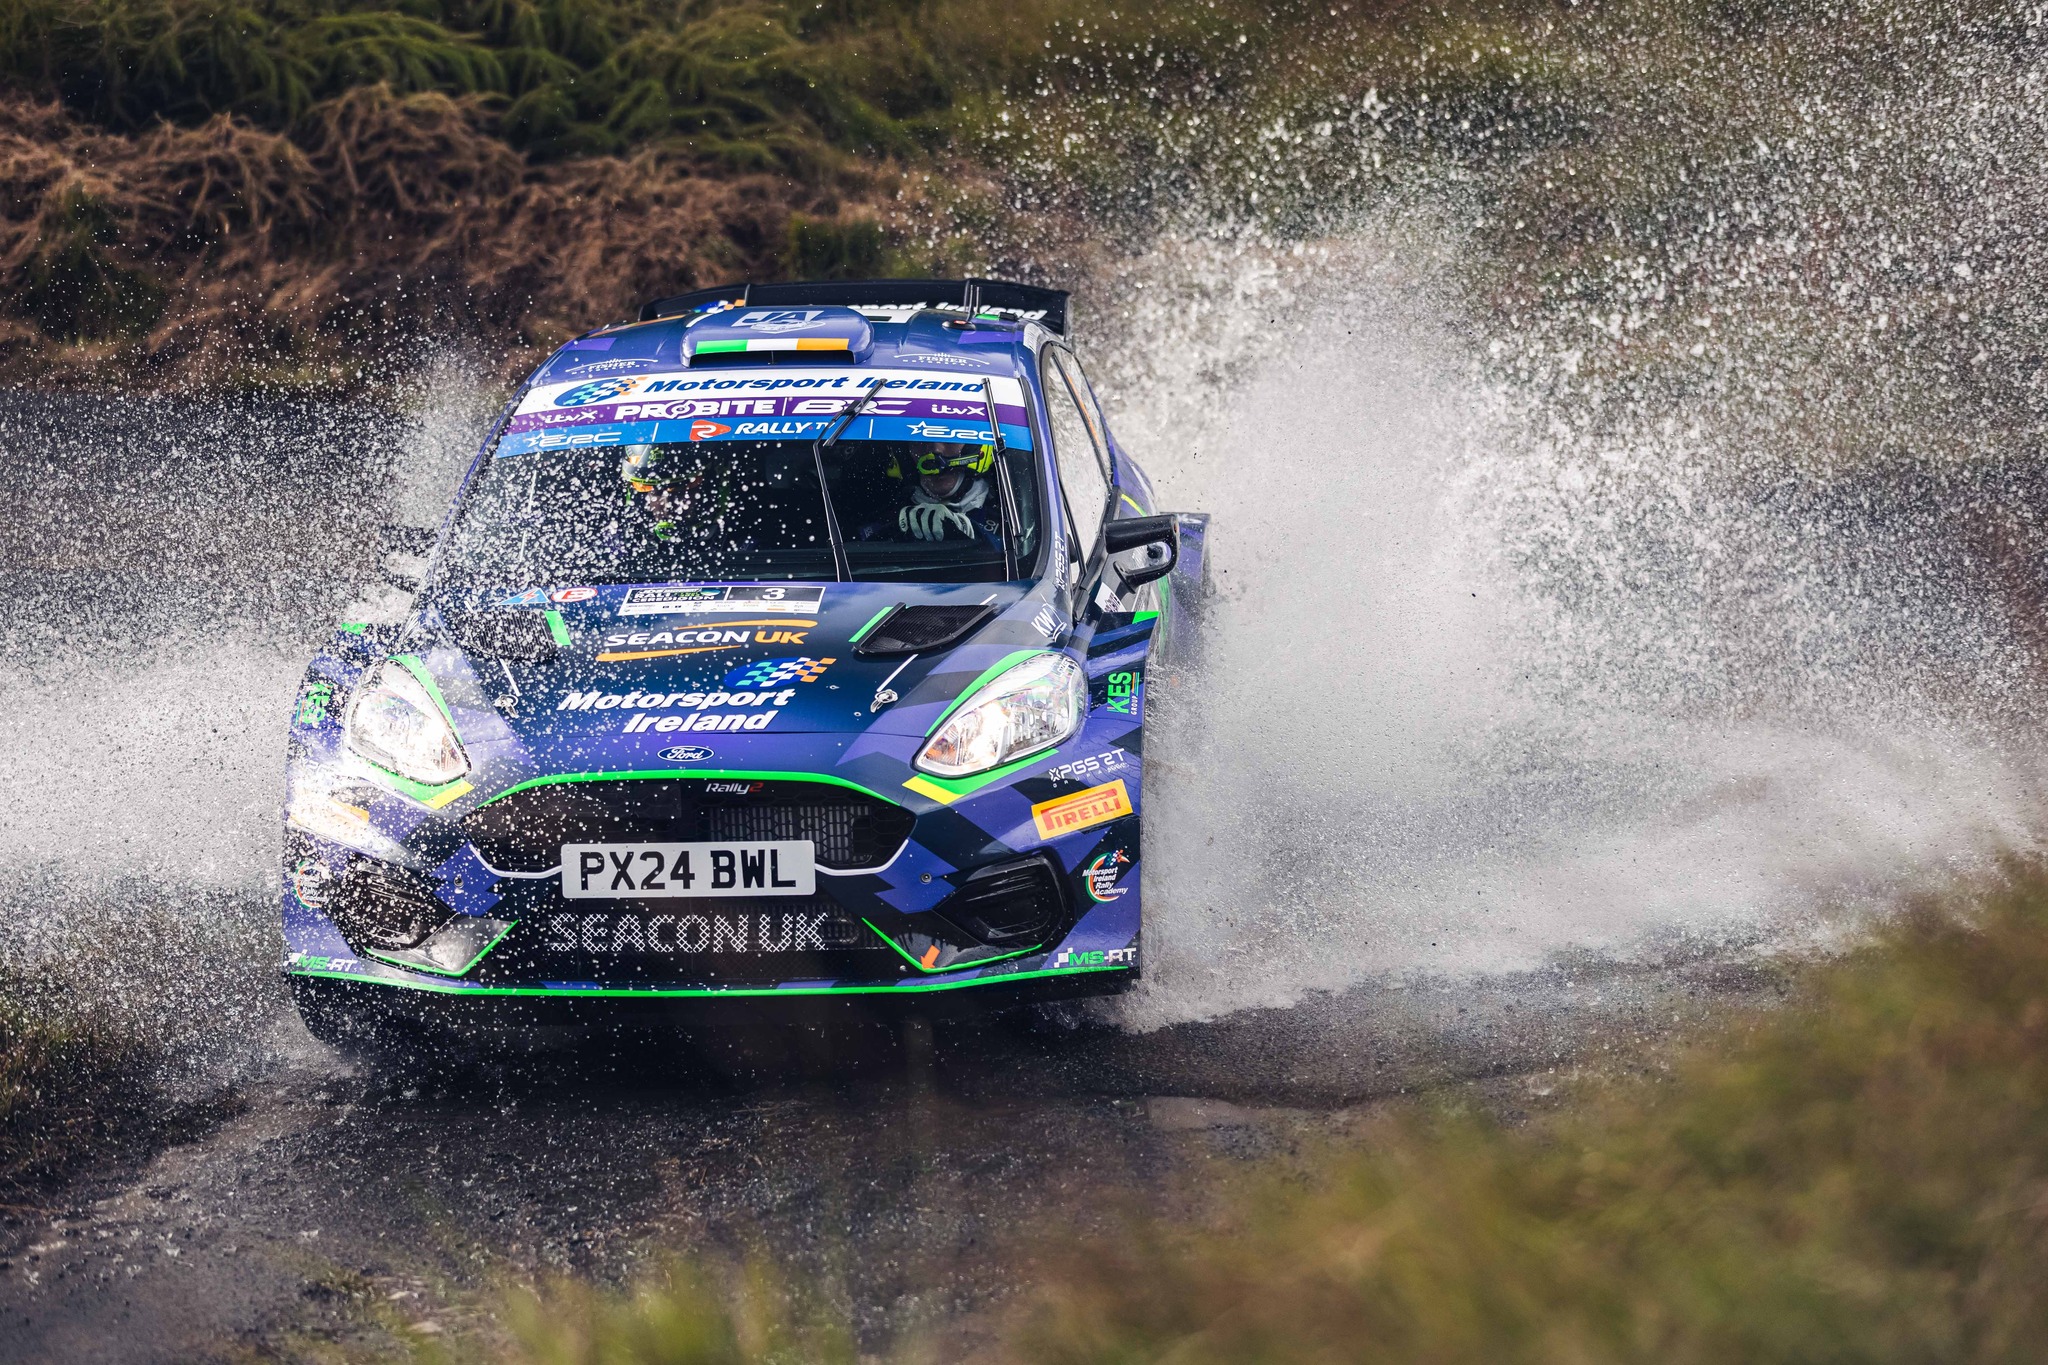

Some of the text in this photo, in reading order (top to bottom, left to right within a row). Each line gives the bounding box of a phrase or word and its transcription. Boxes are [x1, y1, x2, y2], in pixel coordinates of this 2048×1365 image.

[917, 355, 967, 364] FISHER
[643, 377, 985, 393] Motorsport Ireland
[614, 399, 777, 420] PROBITE
[931, 404, 985, 416] itvX
[762, 588, 786, 600] 3
[605, 630, 809, 647] SEACON UK
[556, 688, 796, 712] Motorsport
[1107, 672, 1132, 714] KES
[622, 710, 780, 733] Ireland
[666, 748, 704, 760] Ford
[706, 782, 764, 795] Rally2
[1040, 788, 1122, 831] PIRELLI
[580, 848, 797, 891] PX24 BWL
[1082, 867, 1118, 877] Motorsport
[1093, 874, 1117, 883] Ireland
[1095, 882, 1114, 890] Rally
[1094, 887, 1129, 896] Academy
[550, 912, 829, 953] SEACON UK
[294, 954, 358, 972] MS-RT
[1067, 947, 1137, 966] MS-RT
